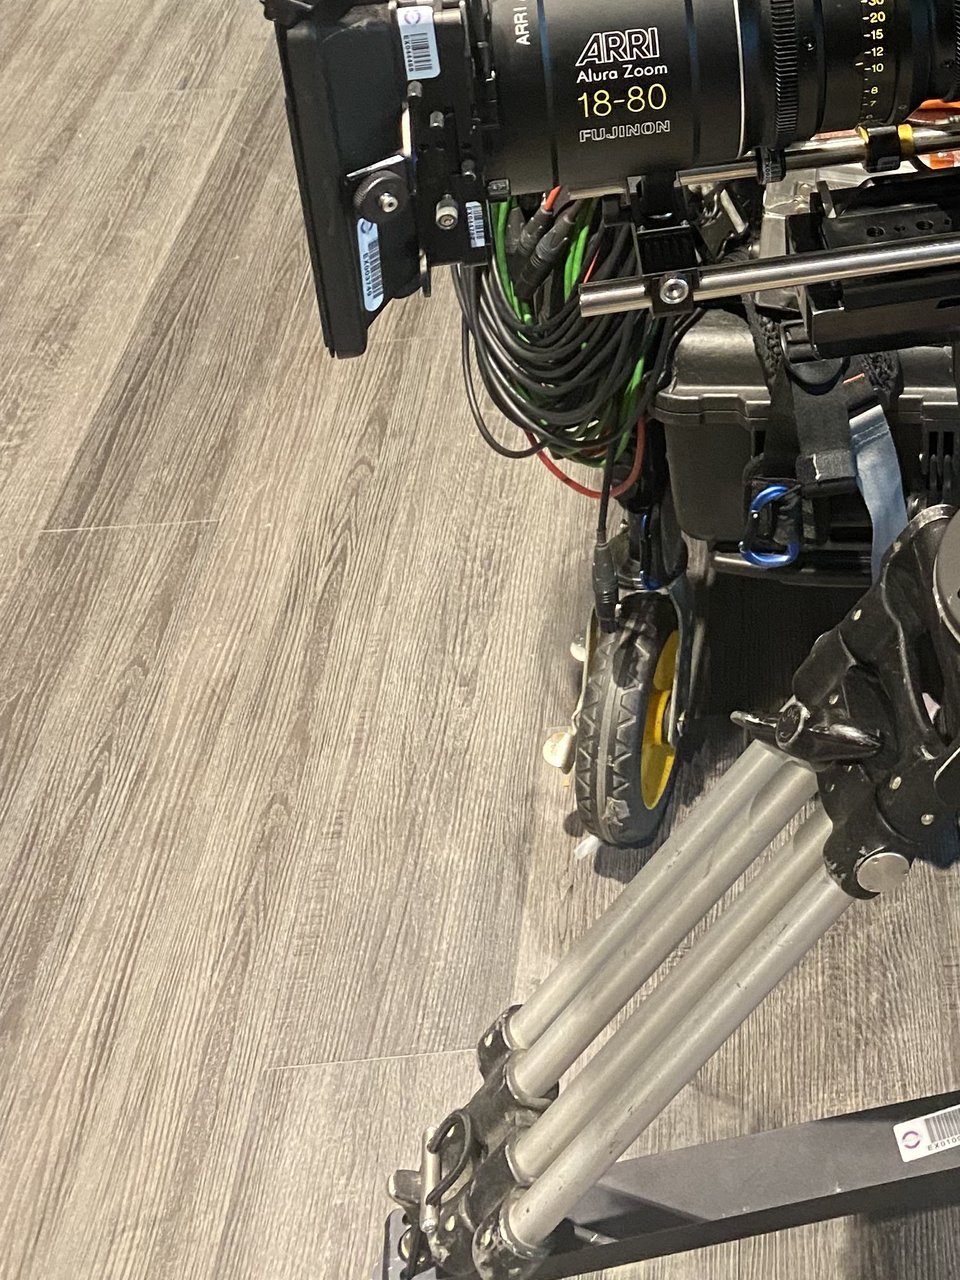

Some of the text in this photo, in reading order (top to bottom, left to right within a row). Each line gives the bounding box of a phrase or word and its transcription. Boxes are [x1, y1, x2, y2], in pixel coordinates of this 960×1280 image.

[512, 6, 531, 46] ARRI
[869, 11, 886, 23] 20
[870, 28, 884, 40] 15
[575, 27, 660, 67] ARRI
[871, 46, 884, 57] 12
[576, 64, 668, 83] Alura Zoom
[871, 63, 884, 72] 10
[577, 83, 667, 118] 18-80
[579, 120, 671, 143] FUJINON
